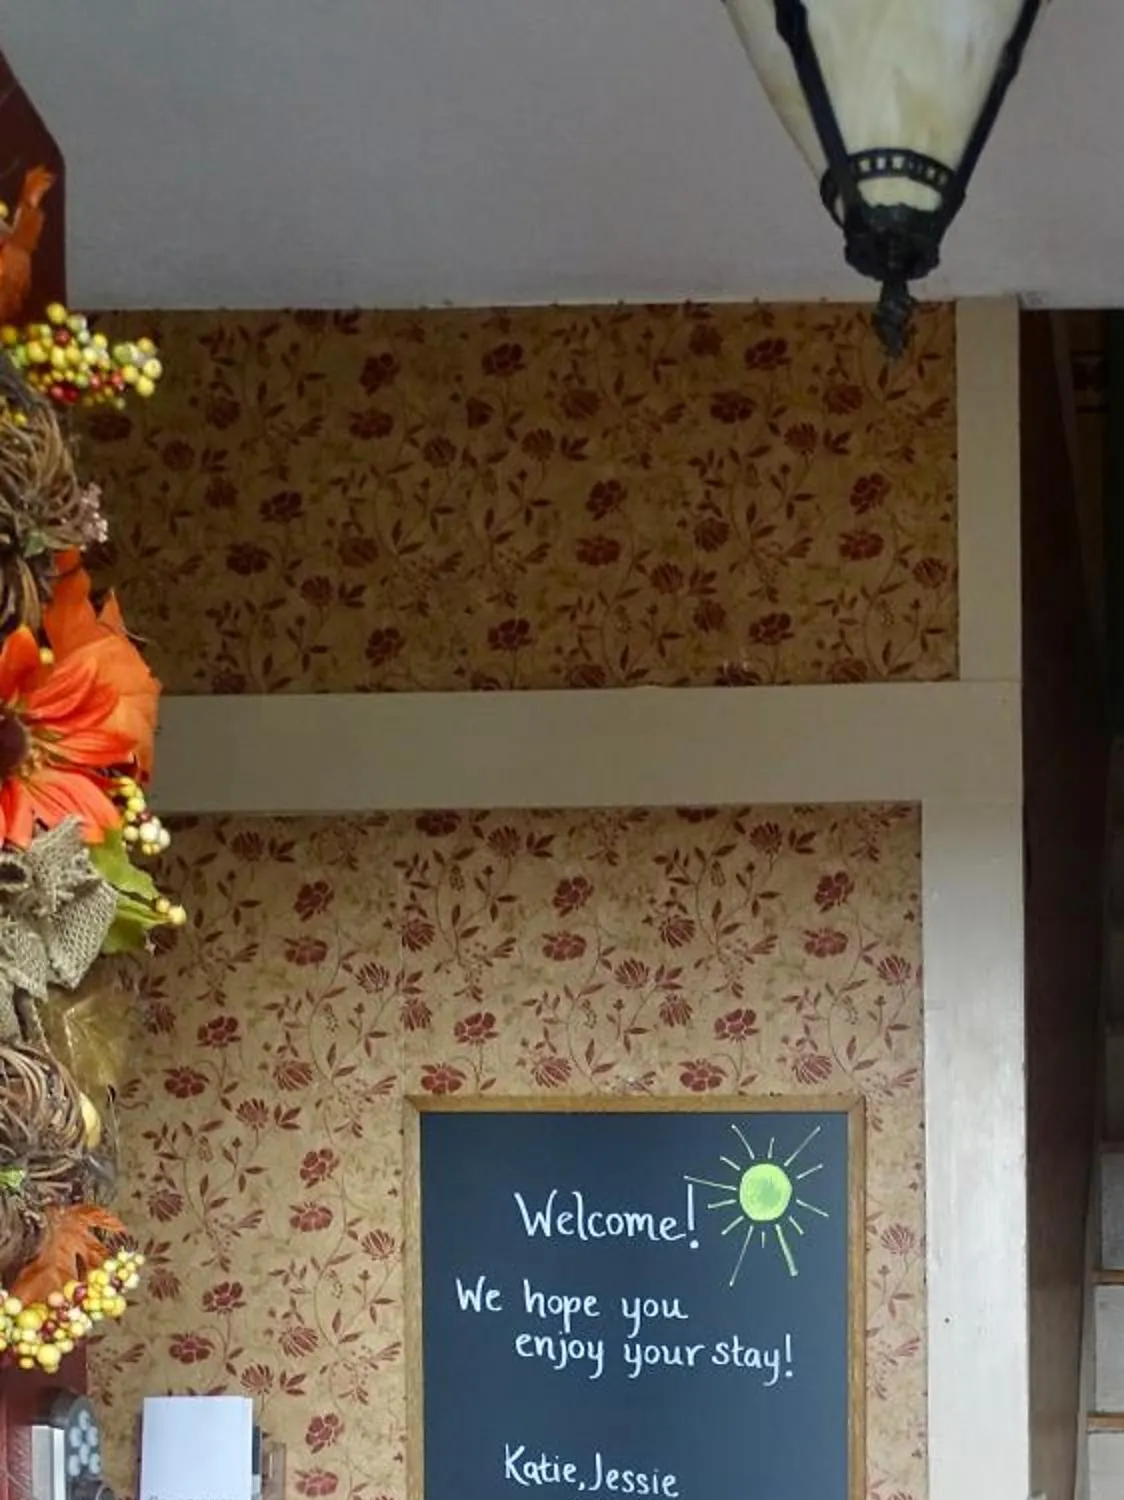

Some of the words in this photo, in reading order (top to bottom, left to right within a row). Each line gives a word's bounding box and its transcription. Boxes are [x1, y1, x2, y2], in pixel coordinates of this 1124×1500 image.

[513, 1182, 701, 1250] Welcome!
[455, 1275, 503, 1313] We
[523, 1278, 601, 1334] hope
[621, 1296, 690, 1339] you
[514, 1332, 605, 1380] enjoy
[623, 1342, 706, 1379] your
[710, 1333, 794, 1387] stay!
[588, 1452, 680, 1498] Jessie
